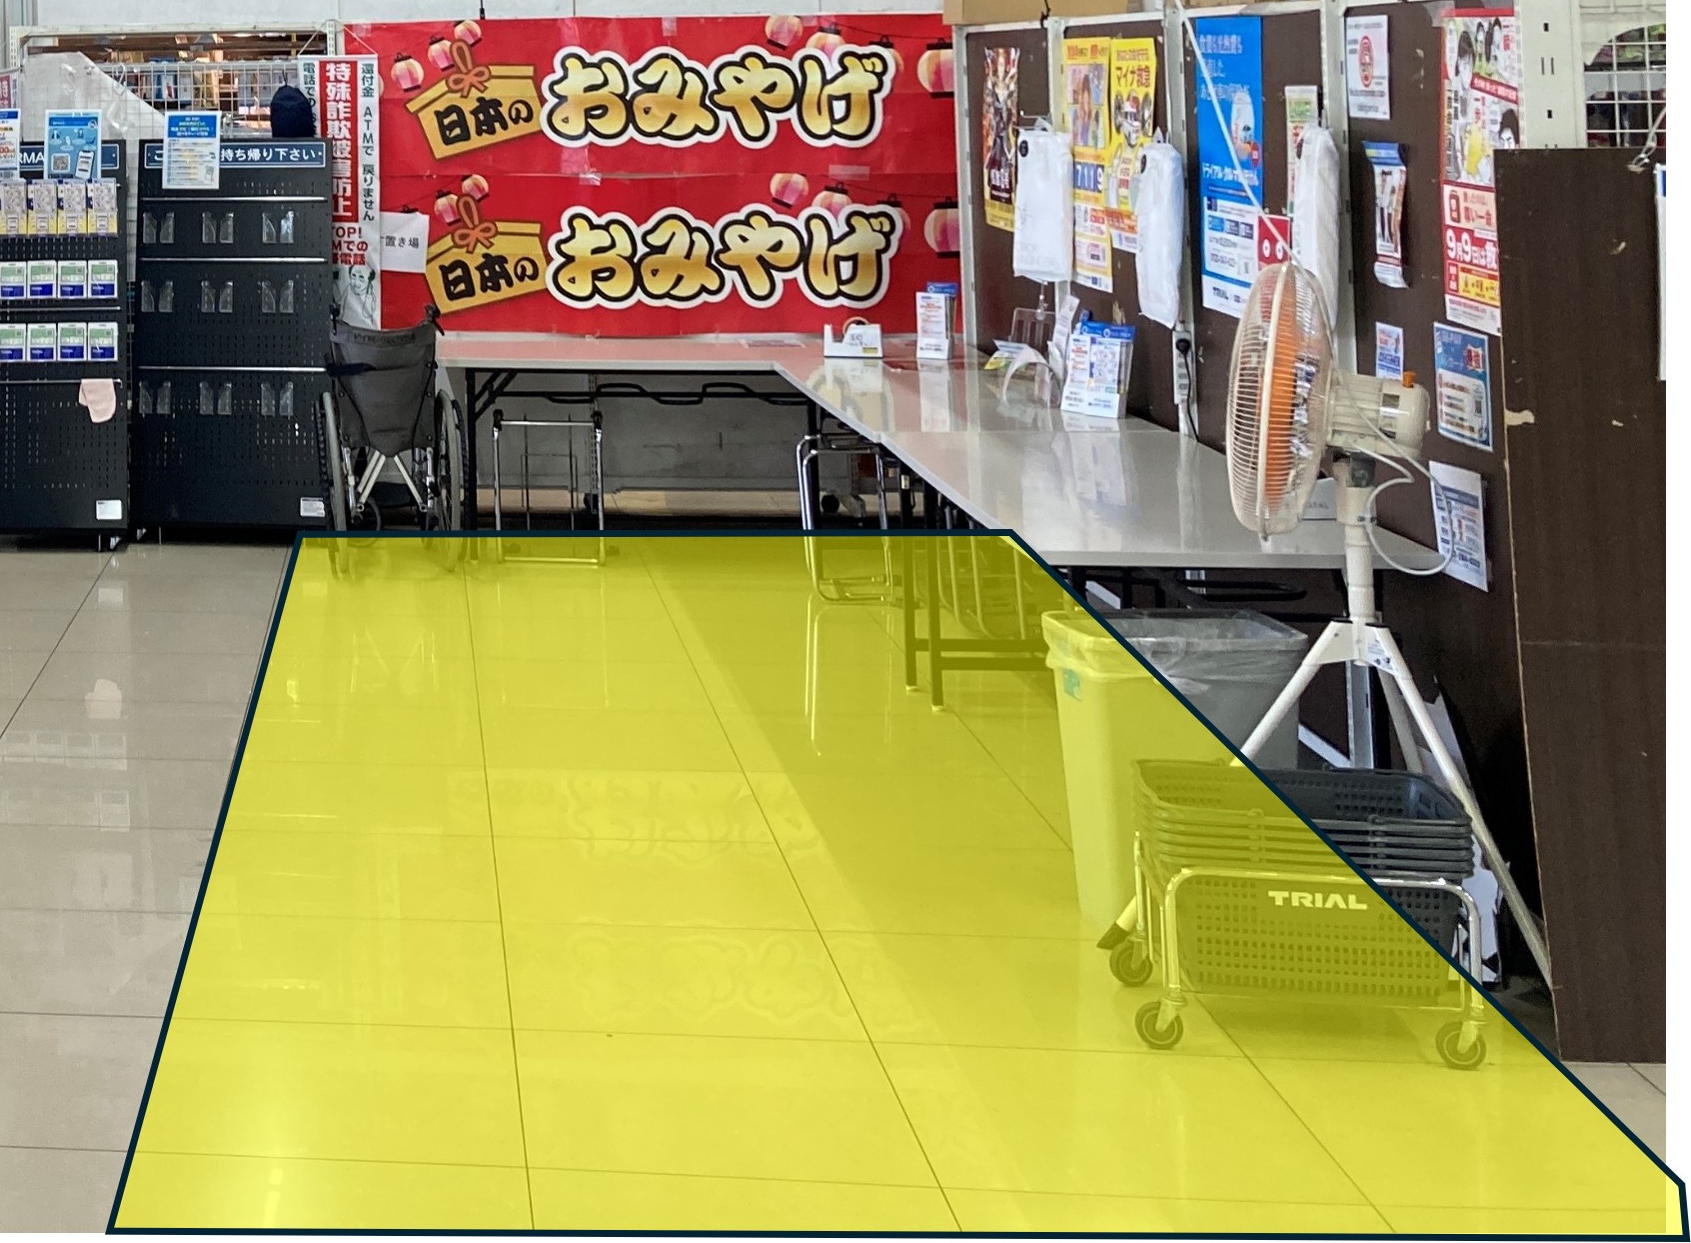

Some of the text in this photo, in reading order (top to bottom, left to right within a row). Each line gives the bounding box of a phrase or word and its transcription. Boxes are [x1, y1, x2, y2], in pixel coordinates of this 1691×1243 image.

[435, 50, 891, 145] 日本の おみやげ
[1115, 65, 1151, 88] マイナ救急
[362, 105, 375, 156] ATMで
[362, 163, 375, 221] 戻りません
[440, 210, 900, 301] 日本の おみやげ
[1267, 890, 1368, 911] TRIAL
